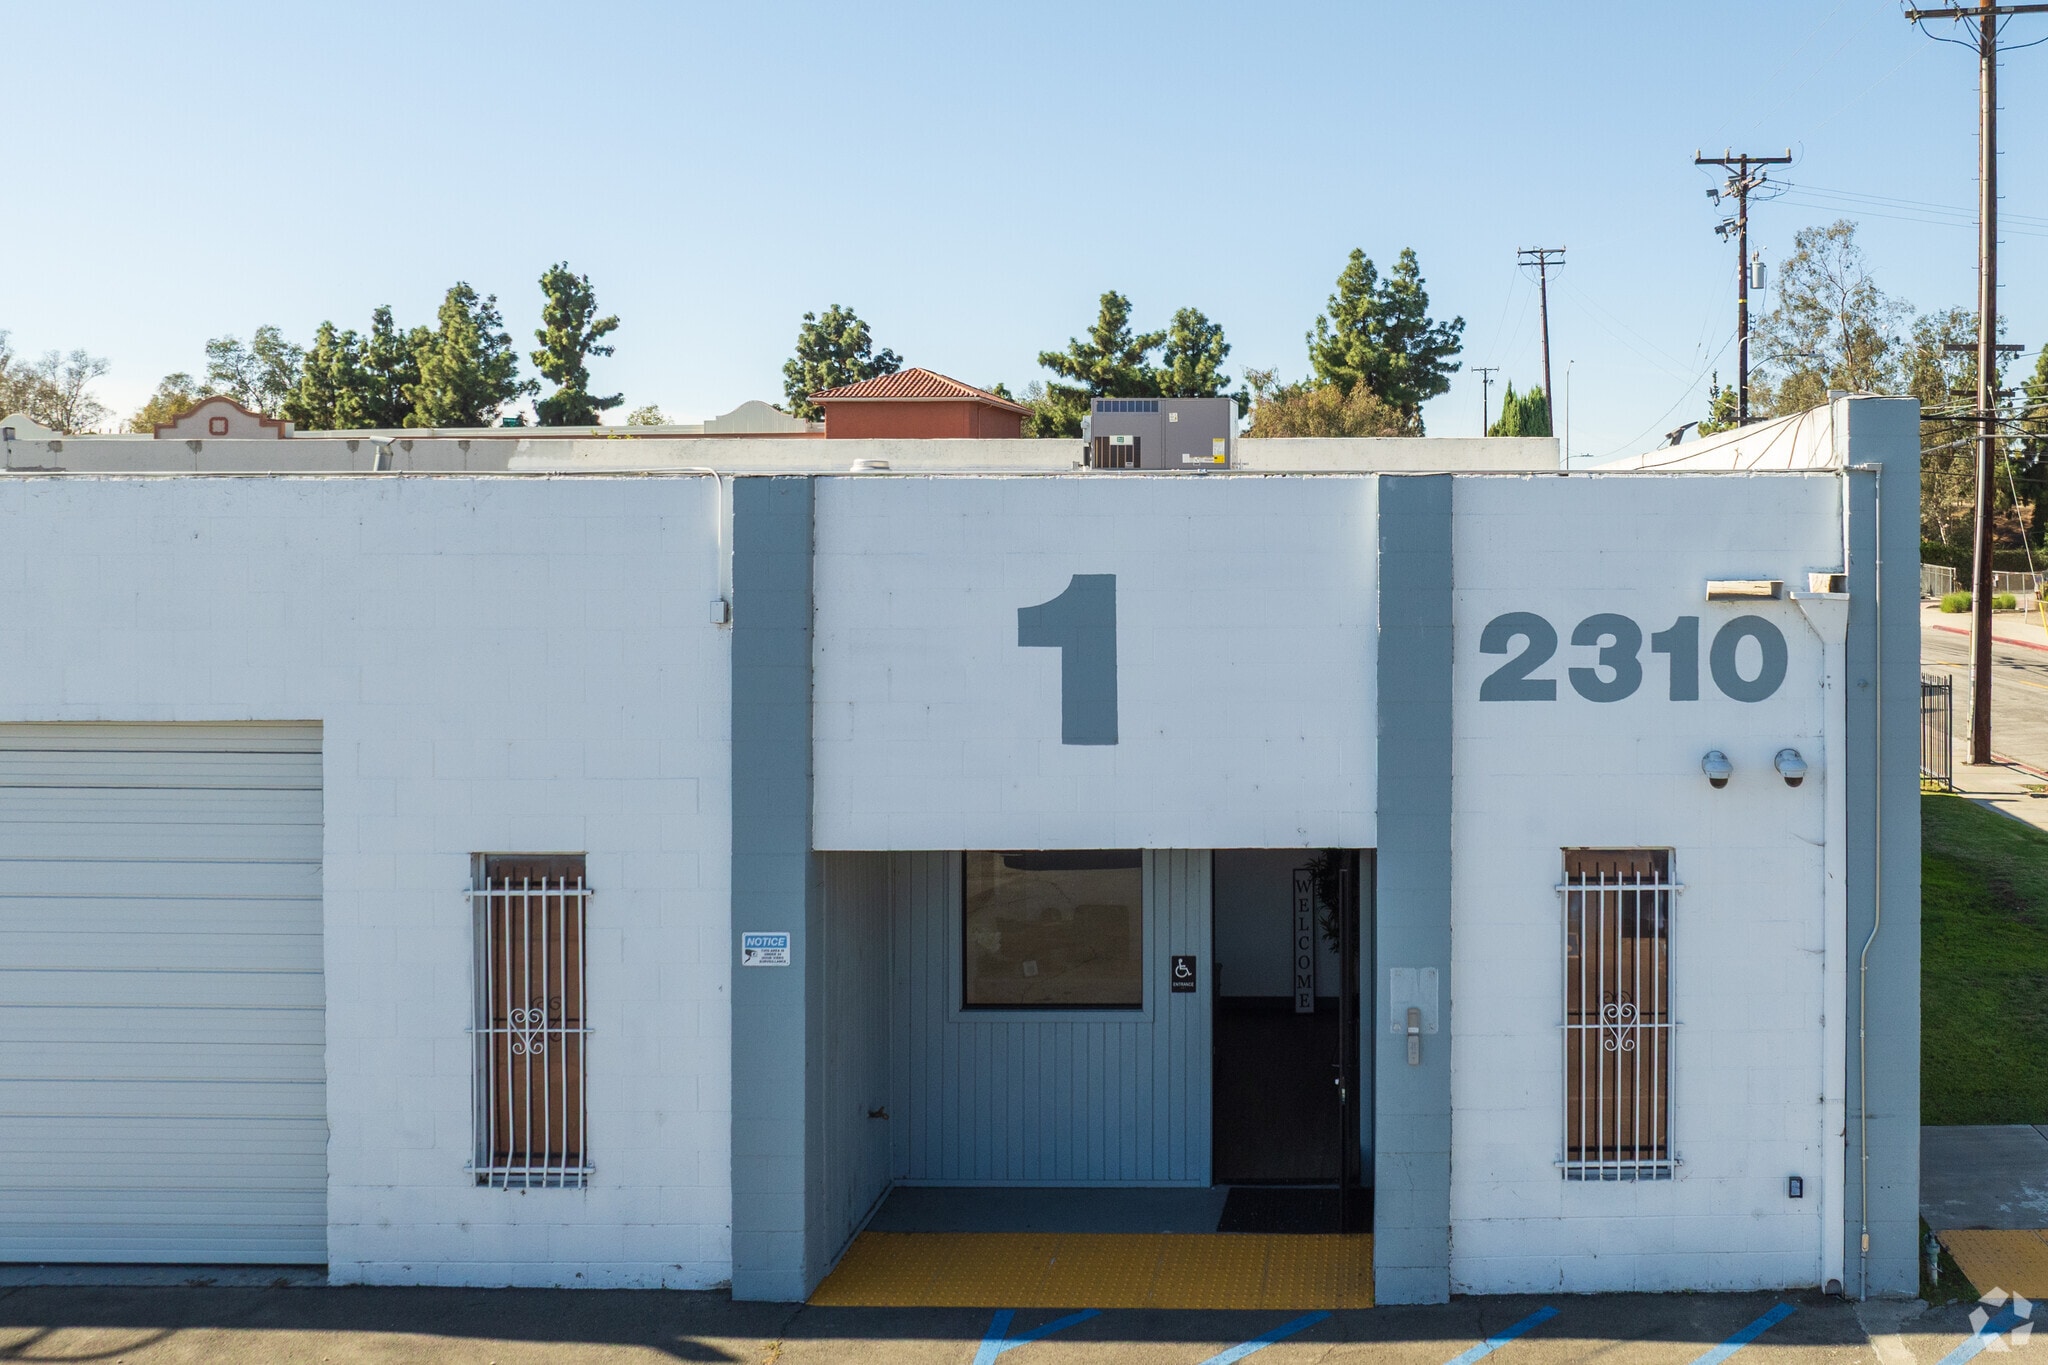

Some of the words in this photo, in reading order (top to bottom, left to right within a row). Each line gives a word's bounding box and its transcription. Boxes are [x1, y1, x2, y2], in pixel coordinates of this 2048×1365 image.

[1017, 574, 1119, 745] 1
[1479, 611, 1788, 703] 2310
[746, 937, 785, 946] NOTICE
[1296, 879, 1312, 1008] WELCOME
